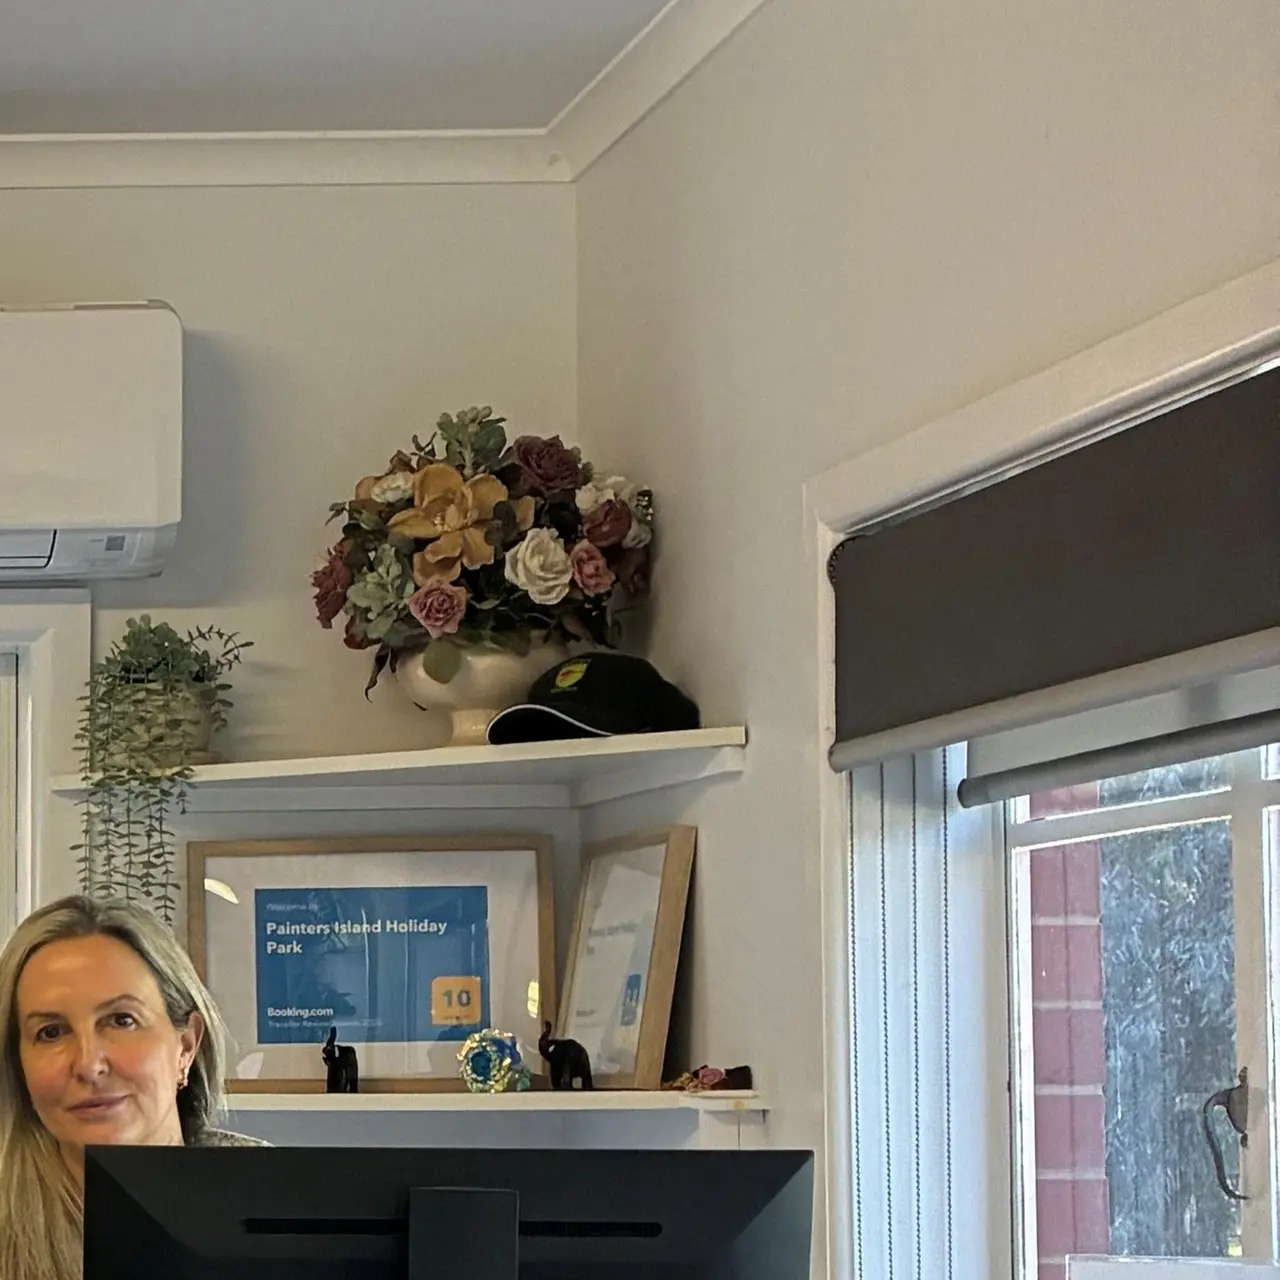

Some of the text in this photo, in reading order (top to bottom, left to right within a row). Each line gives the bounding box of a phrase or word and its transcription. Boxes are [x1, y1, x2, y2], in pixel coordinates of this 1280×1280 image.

[266, 918, 448, 936] Painters Island Holiday
[266, 941, 302, 955] Park
[442, 990, 472, 1008] 10
[267, 1006, 334, 1018] Booking.com
